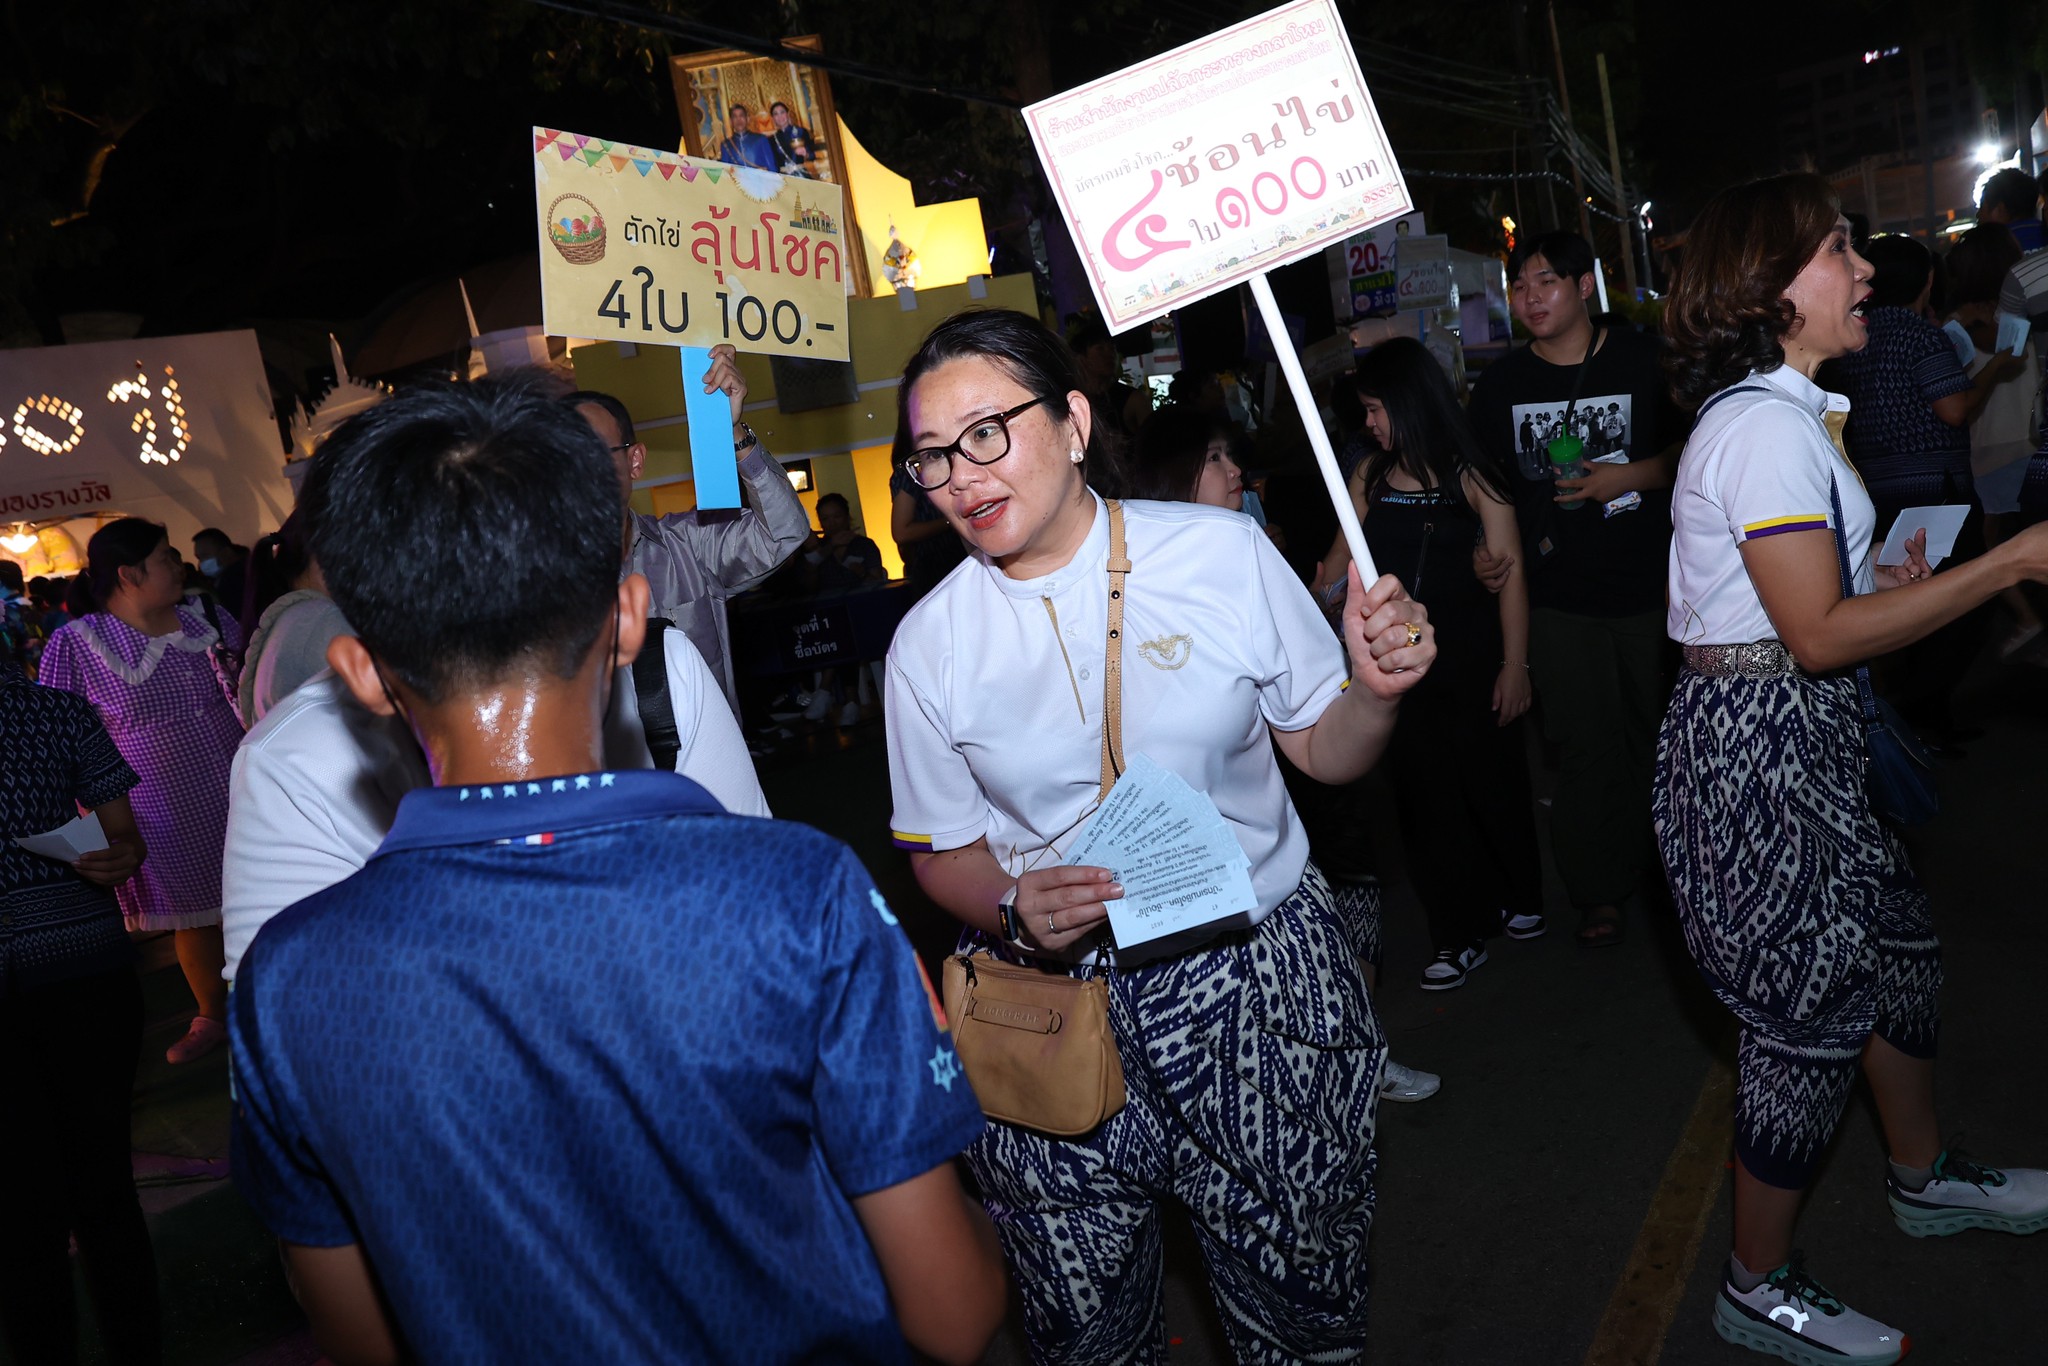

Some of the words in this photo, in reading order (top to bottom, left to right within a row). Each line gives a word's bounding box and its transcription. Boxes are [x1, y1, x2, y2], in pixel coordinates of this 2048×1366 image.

[1165, 78, 1355, 187] ช้อนไข่
[1189, 219, 1220, 246] ใบ
[1216, 156, 1327, 229] ๑๐๐
[1336, 158, 1380, 189] บาท
[624, 215, 681, 247] ตักไข่
[691, 205, 841, 284] ลุ้นโชค
[716, 292, 835, 347] 100.-
